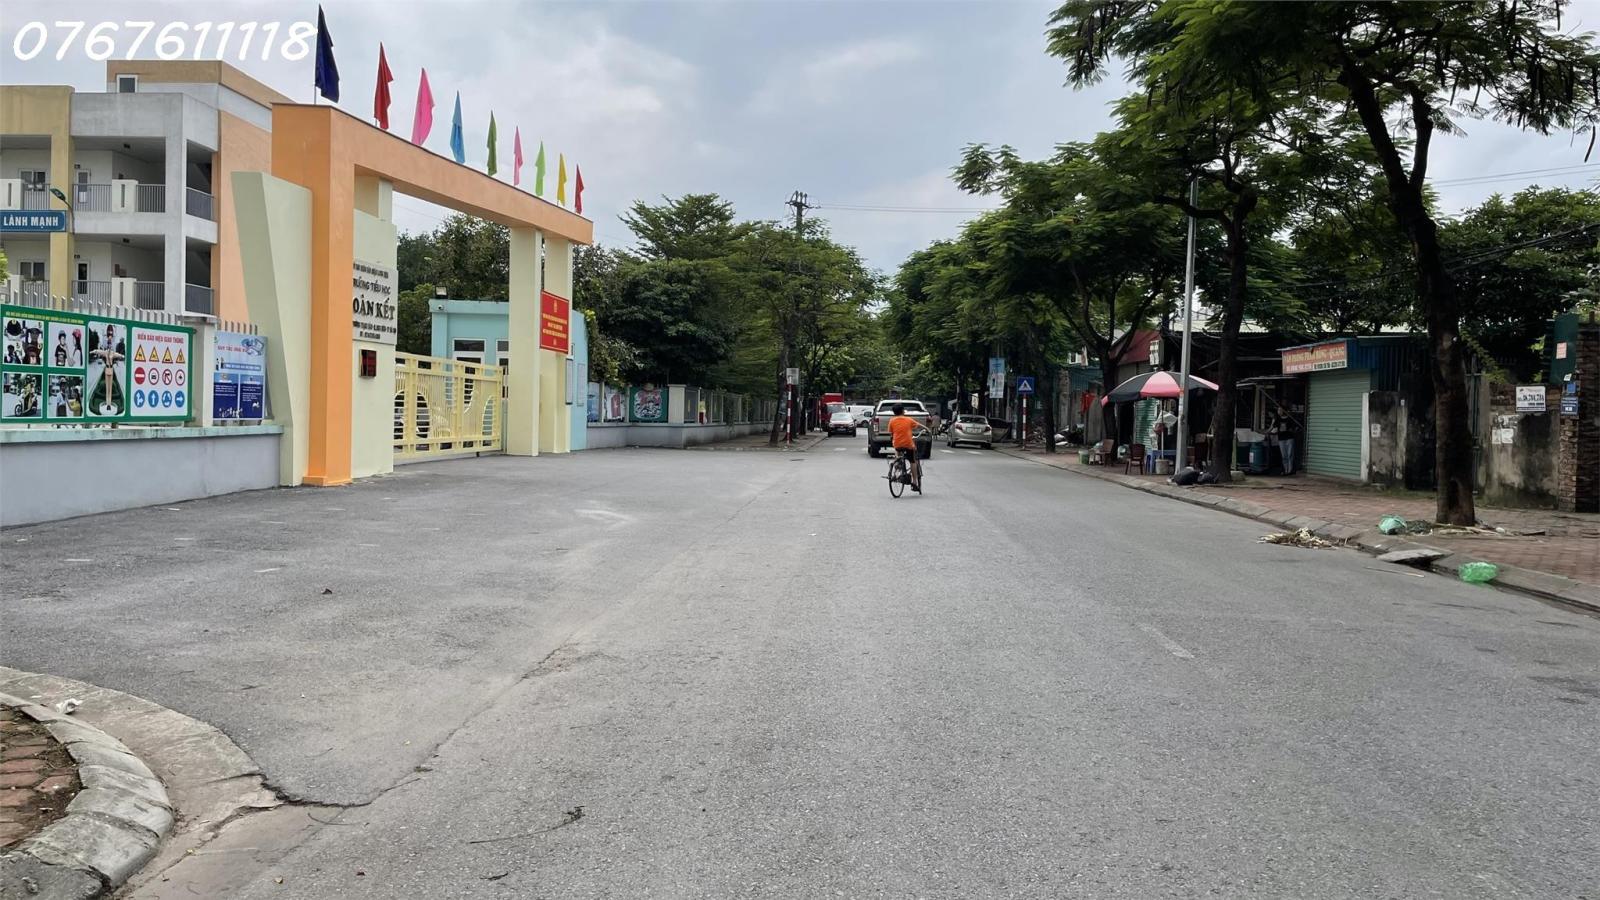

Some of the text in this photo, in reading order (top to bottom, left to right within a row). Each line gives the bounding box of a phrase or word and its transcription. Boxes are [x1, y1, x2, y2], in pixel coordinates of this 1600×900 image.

[3, 213, 59, 229] LÀNH MẠNH
[353, 294, 395, 320] OÀN KẾT
